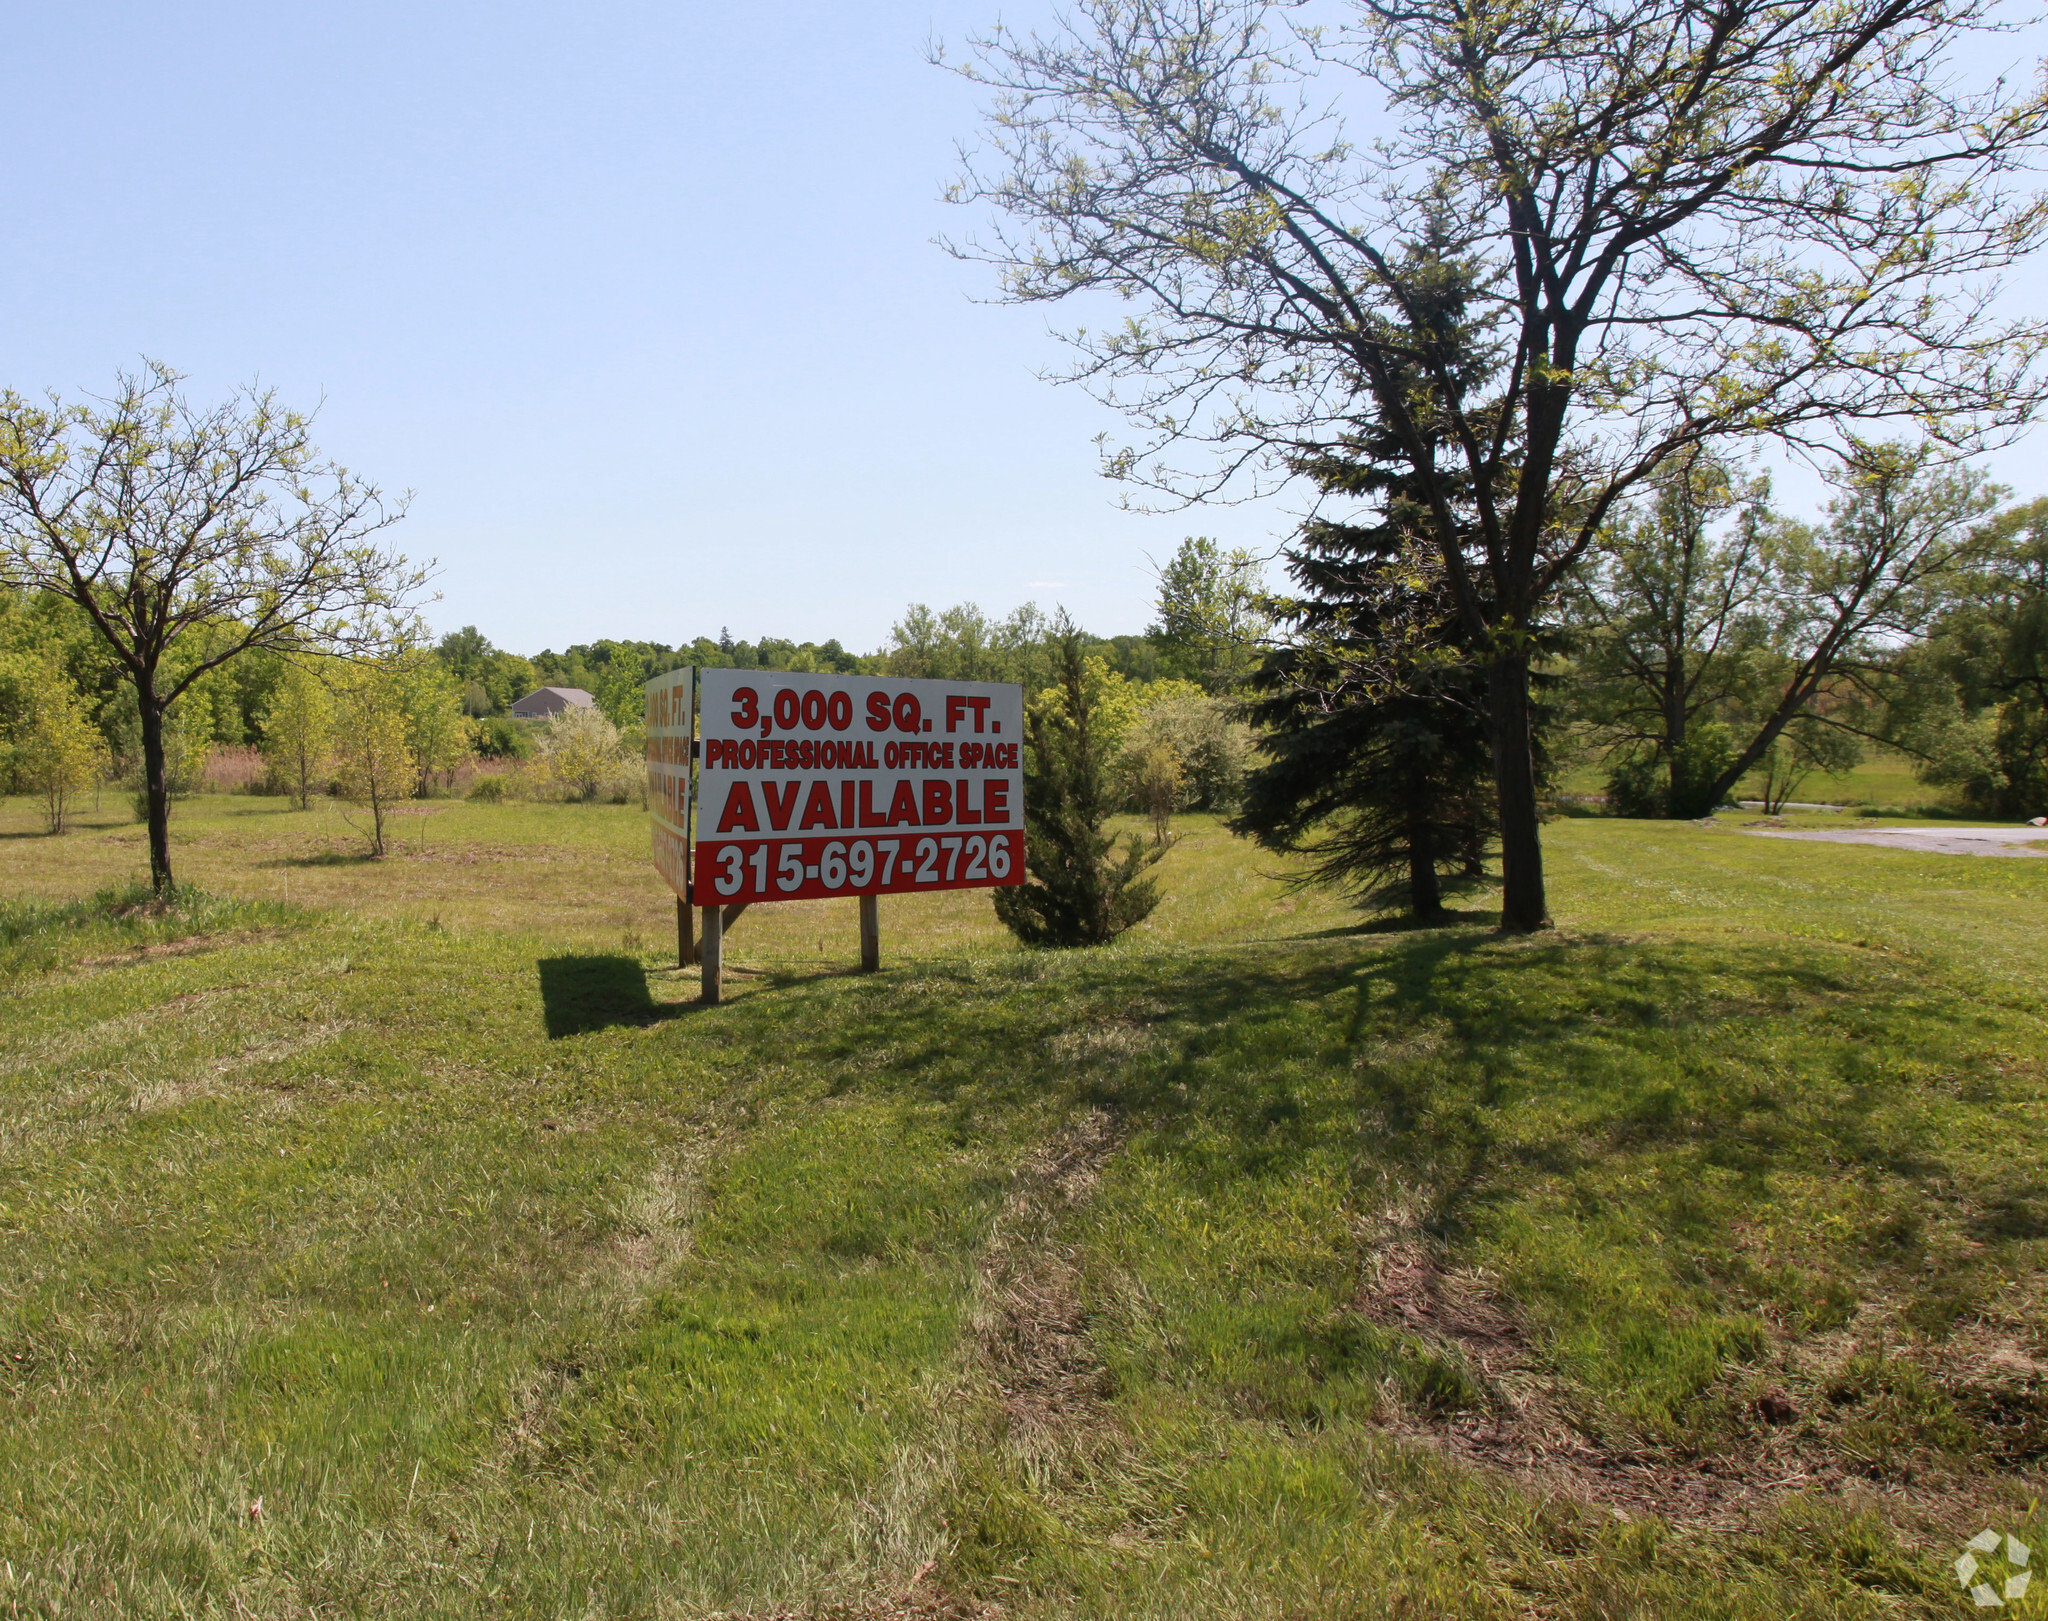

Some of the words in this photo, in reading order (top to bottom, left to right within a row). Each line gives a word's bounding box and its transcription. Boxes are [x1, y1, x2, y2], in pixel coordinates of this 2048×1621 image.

[672, 685, 685, 726] FT.
[731, 687, 853, 739] 3,000
[866, 691, 932, 736] SQ.
[946, 695, 1001, 733] FT.
[705, 739, 879, 769] PROFESSIONAL
[884, 741, 954, 769] OFFICE
[959, 743, 1018, 769] SPACE
[716, 779, 1010, 832] AVAILABLE
[714, 834, 1011, 896] 315-697-2726
